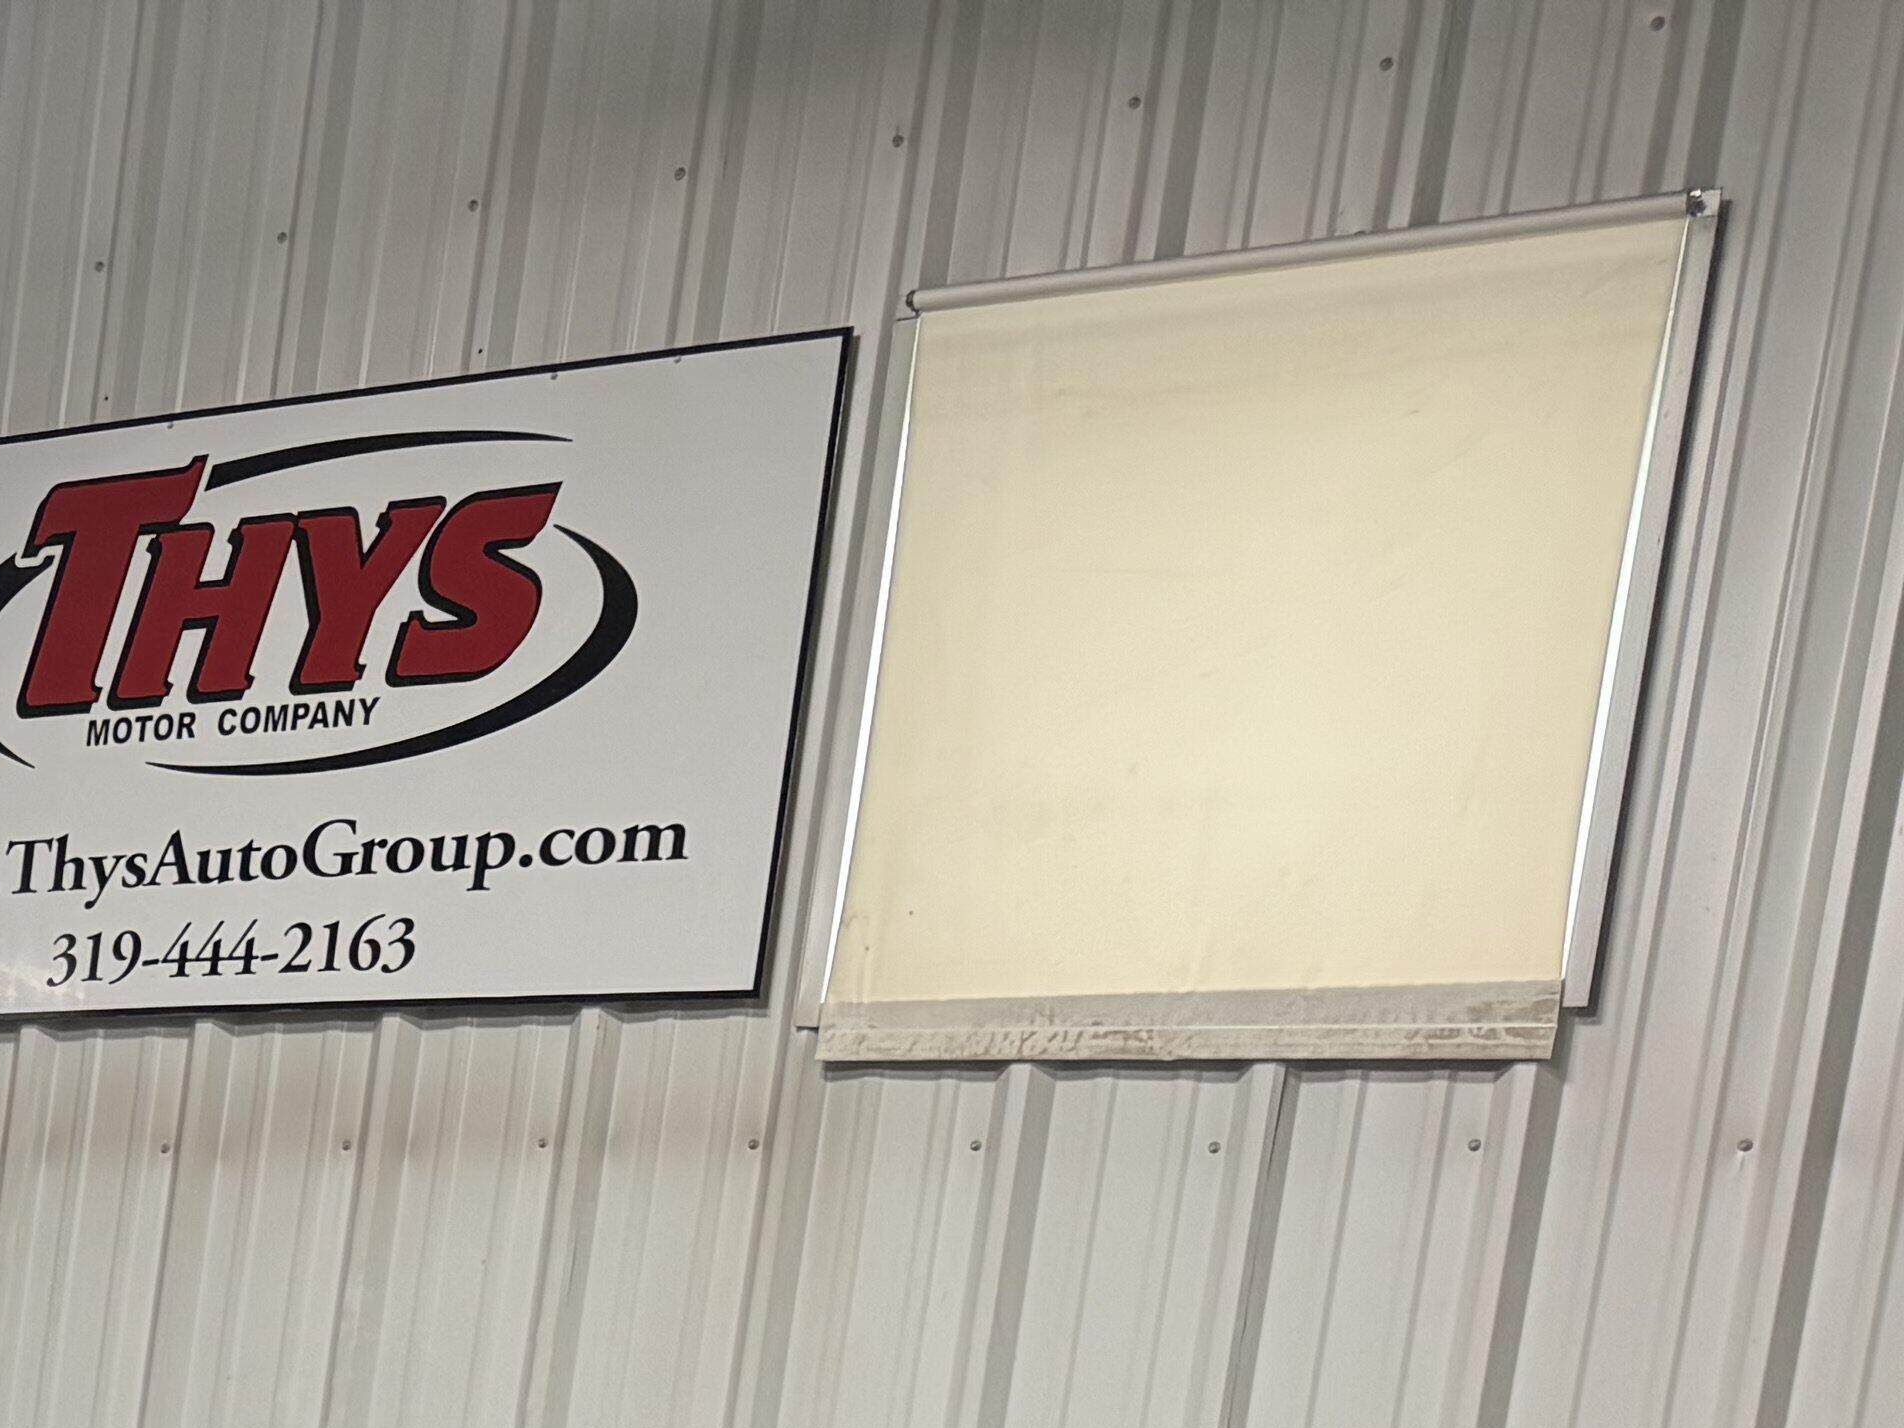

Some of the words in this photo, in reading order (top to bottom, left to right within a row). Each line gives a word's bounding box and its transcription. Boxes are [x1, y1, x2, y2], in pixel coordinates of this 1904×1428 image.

[16, 454, 563, 718] THYS
[86, 713, 196, 747] MOTOR
[218, 697, 380, 736] COMPANY
[47, 914, 416, 988] 319-444-2163
